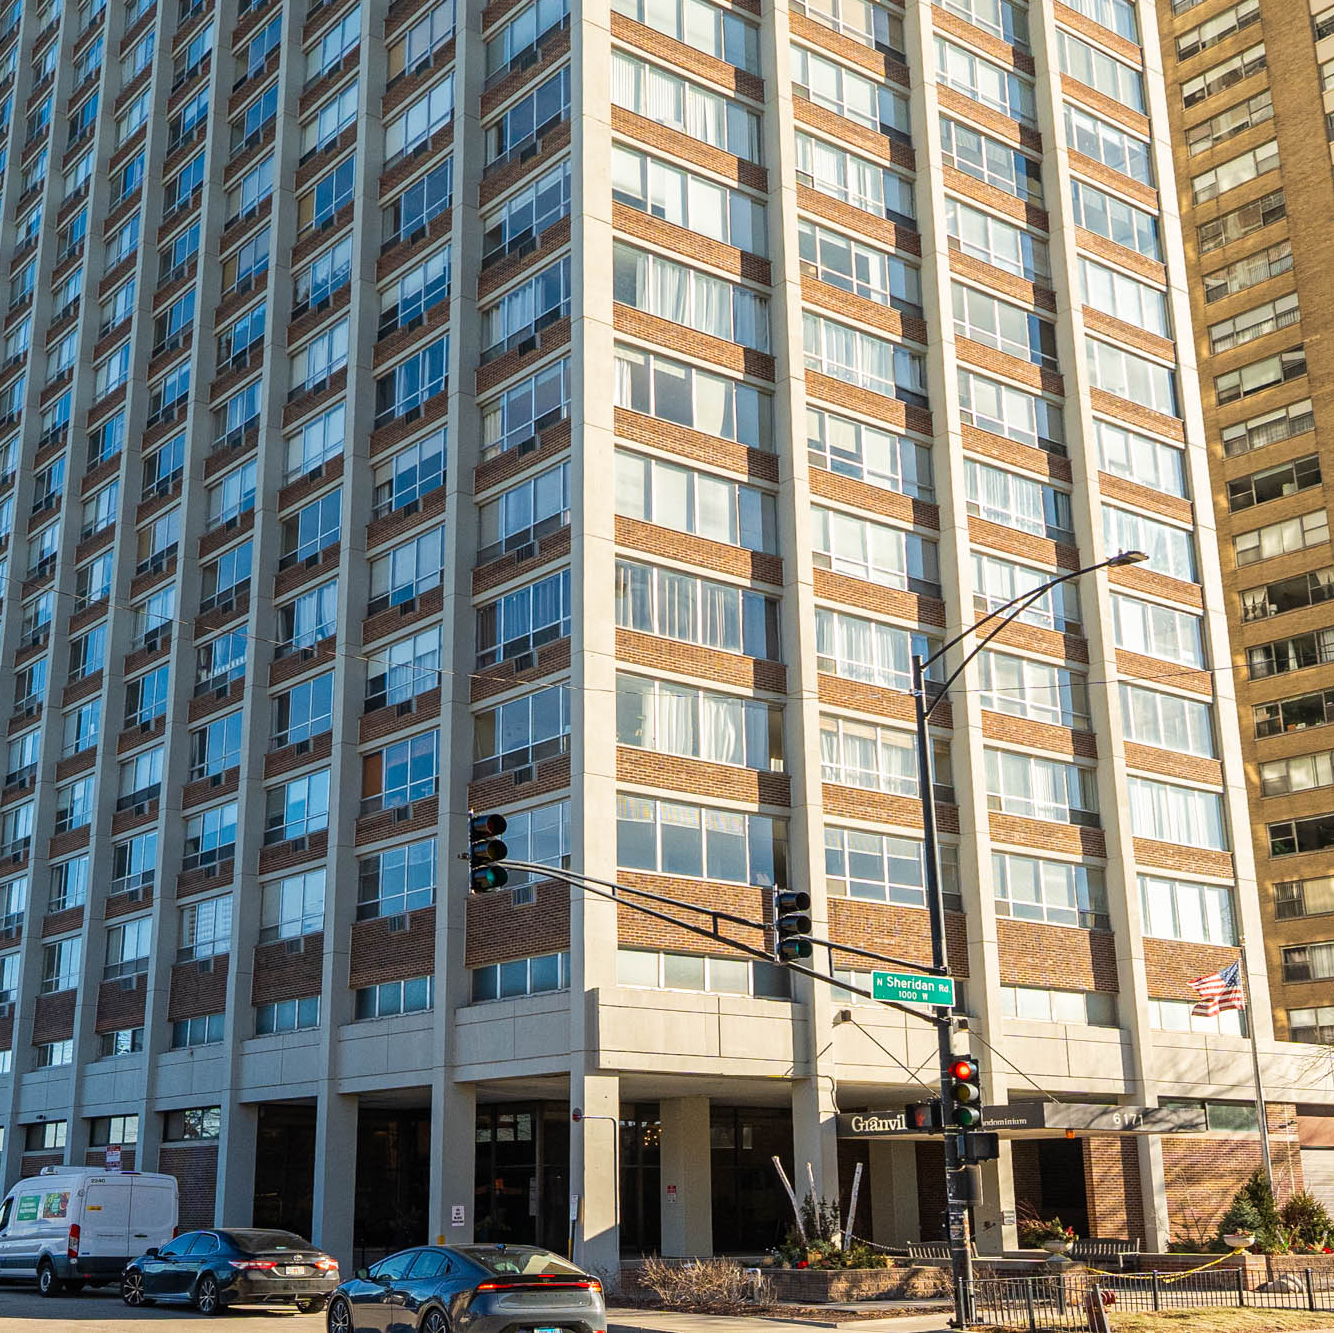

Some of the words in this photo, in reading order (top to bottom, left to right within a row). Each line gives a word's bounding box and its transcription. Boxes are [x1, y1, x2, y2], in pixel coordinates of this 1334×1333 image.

[876, 977, 883, 987] N
[887, 976, 935, 992] Sheridan
[898, 991, 917, 1000] 1000
[851, 1114, 908, 1132] Granvil
[982, 1117, 1027, 1127] ndominium
[1112, 1112, 1144, 1127] 6171
